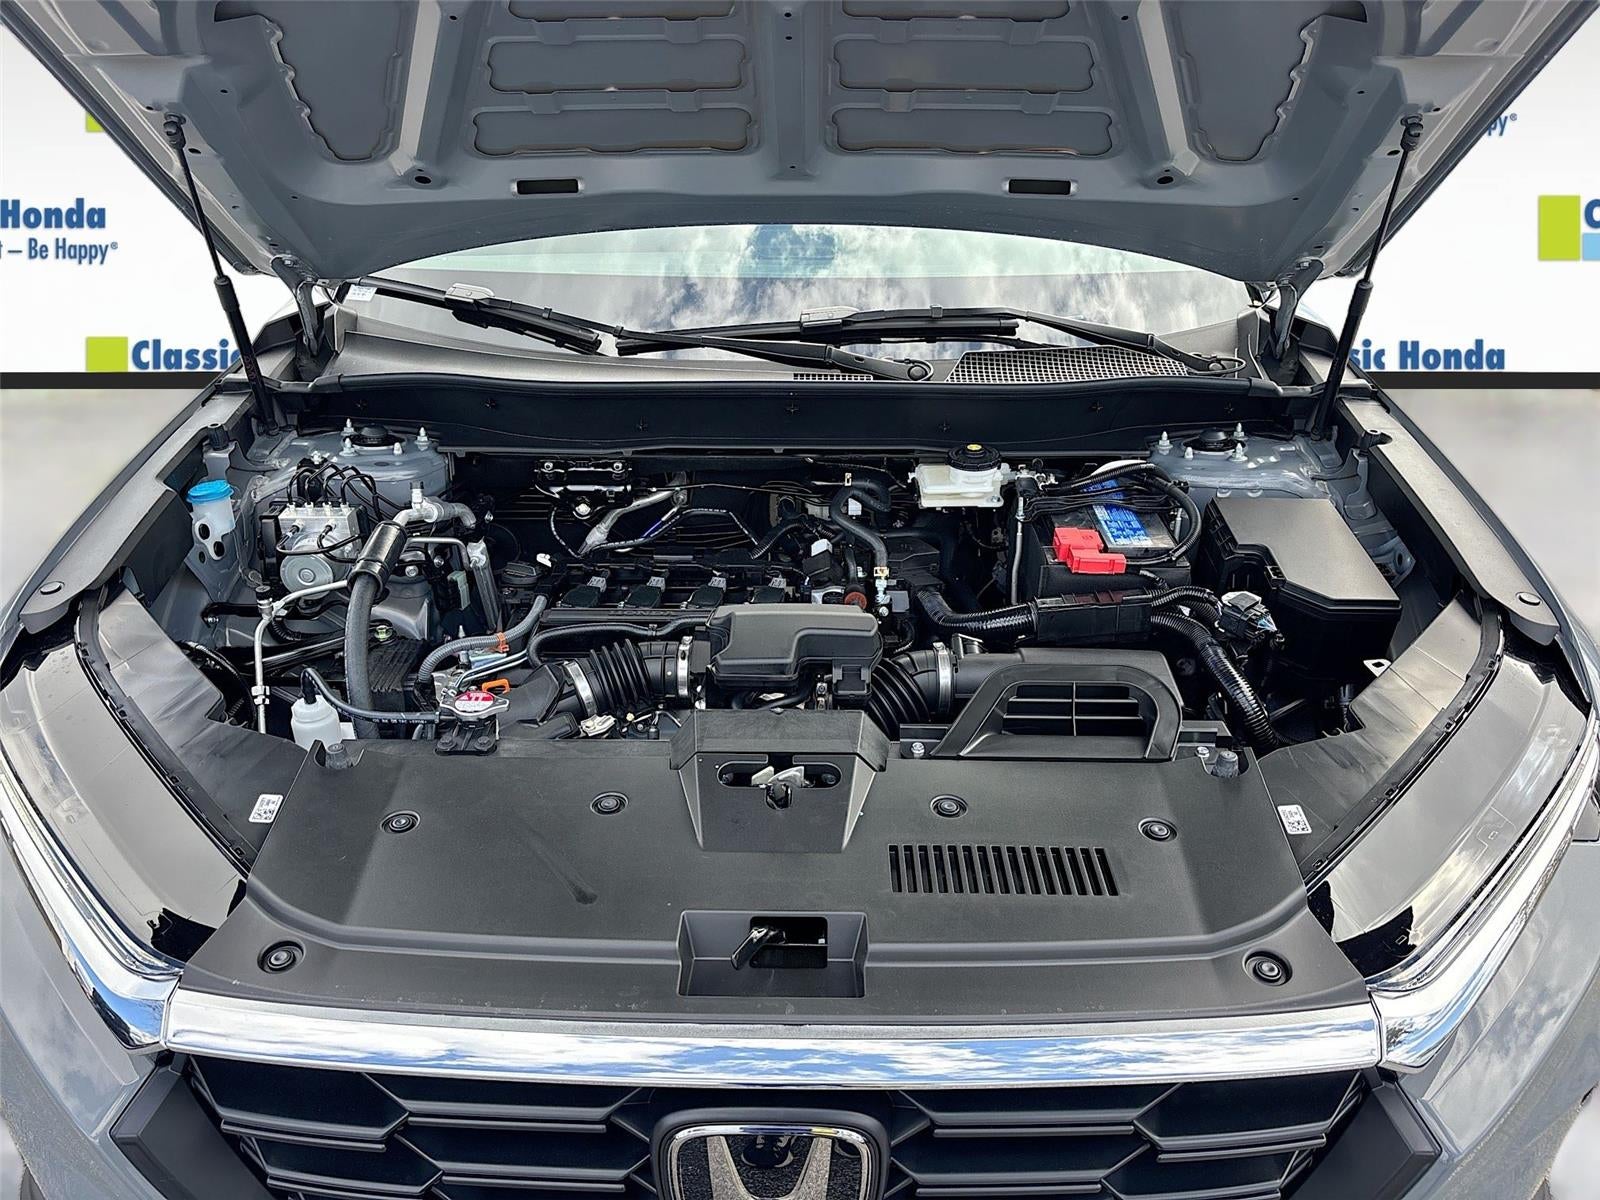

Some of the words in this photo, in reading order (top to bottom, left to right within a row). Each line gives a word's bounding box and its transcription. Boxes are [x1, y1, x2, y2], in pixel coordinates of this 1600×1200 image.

[0, 197, 106, 229] Honda
[28, 237, 49, 260] Be
[1398, 338, 1505, 371] Honda
